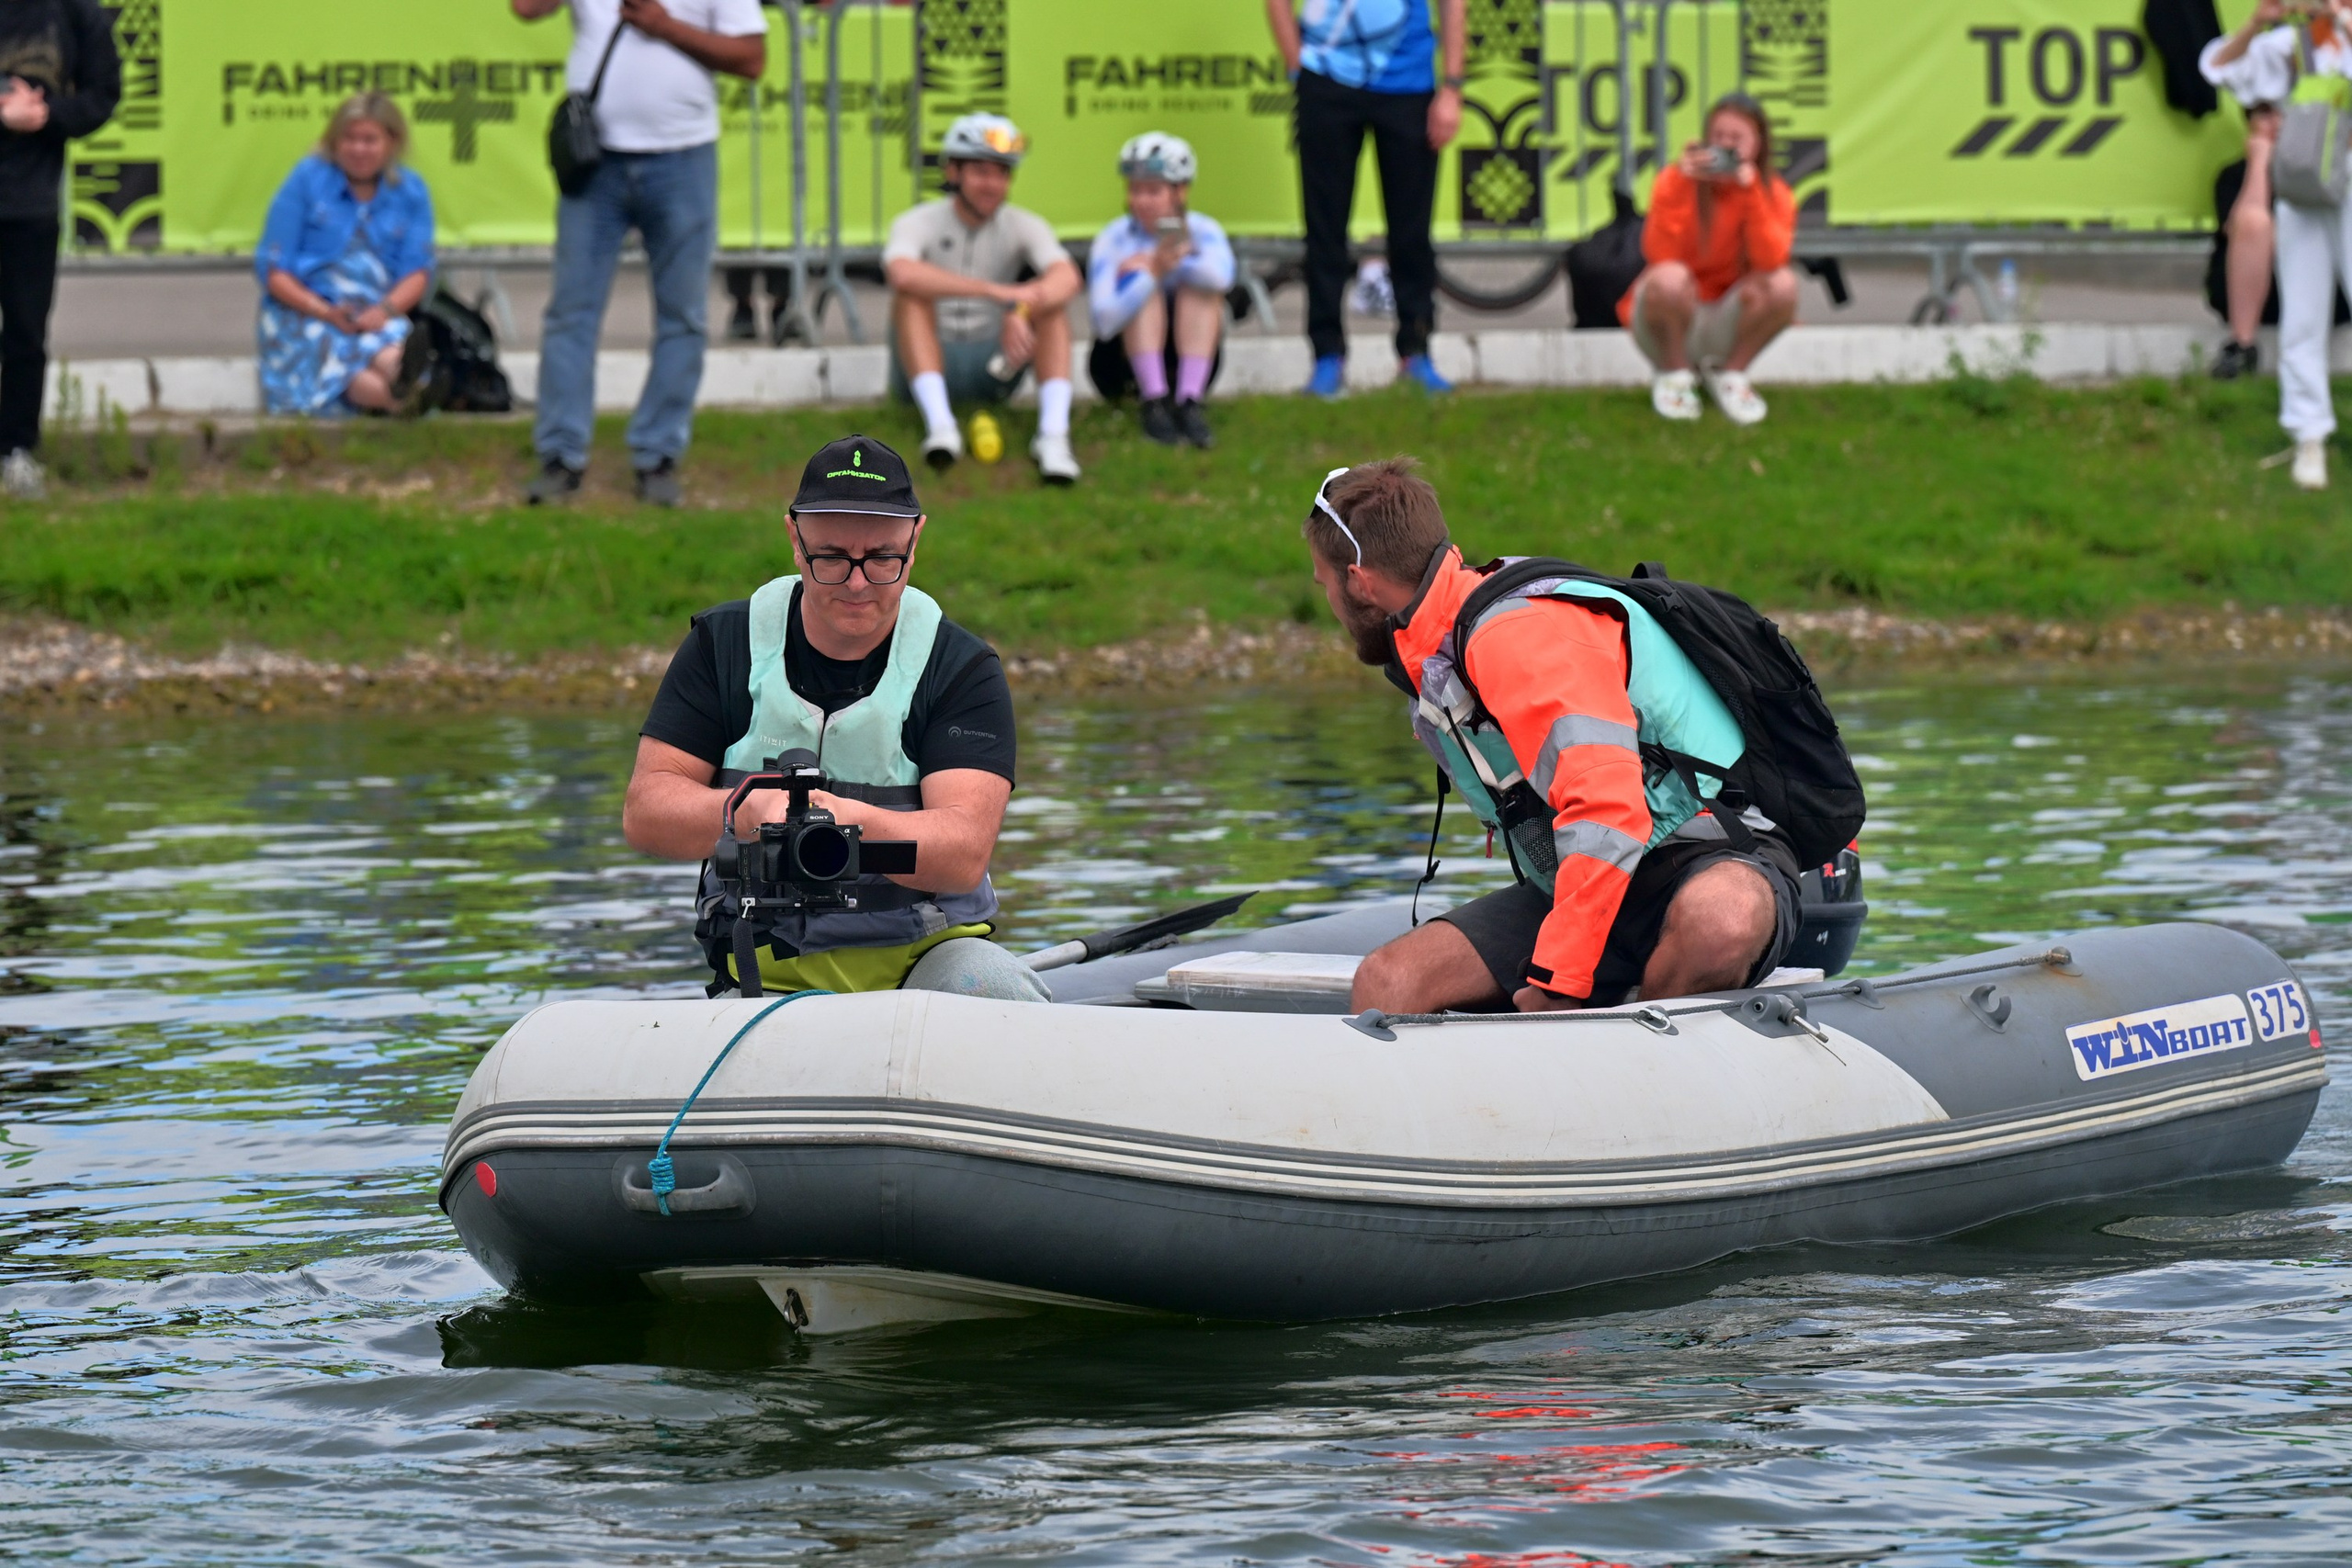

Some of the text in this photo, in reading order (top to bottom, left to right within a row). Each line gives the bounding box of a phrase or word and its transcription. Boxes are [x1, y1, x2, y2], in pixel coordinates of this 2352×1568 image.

[1968, 26, 2145, 107] TOP
[1542, 65, 1688, 134] TOP
[827, 469, 887, 482] ОРГАНИЗАТОР
[759, 735, 787, 747] ITIWIT
[963, 729, 997, 740] OUTVENTURE
[2251, 984, 2306, 1037] 375
